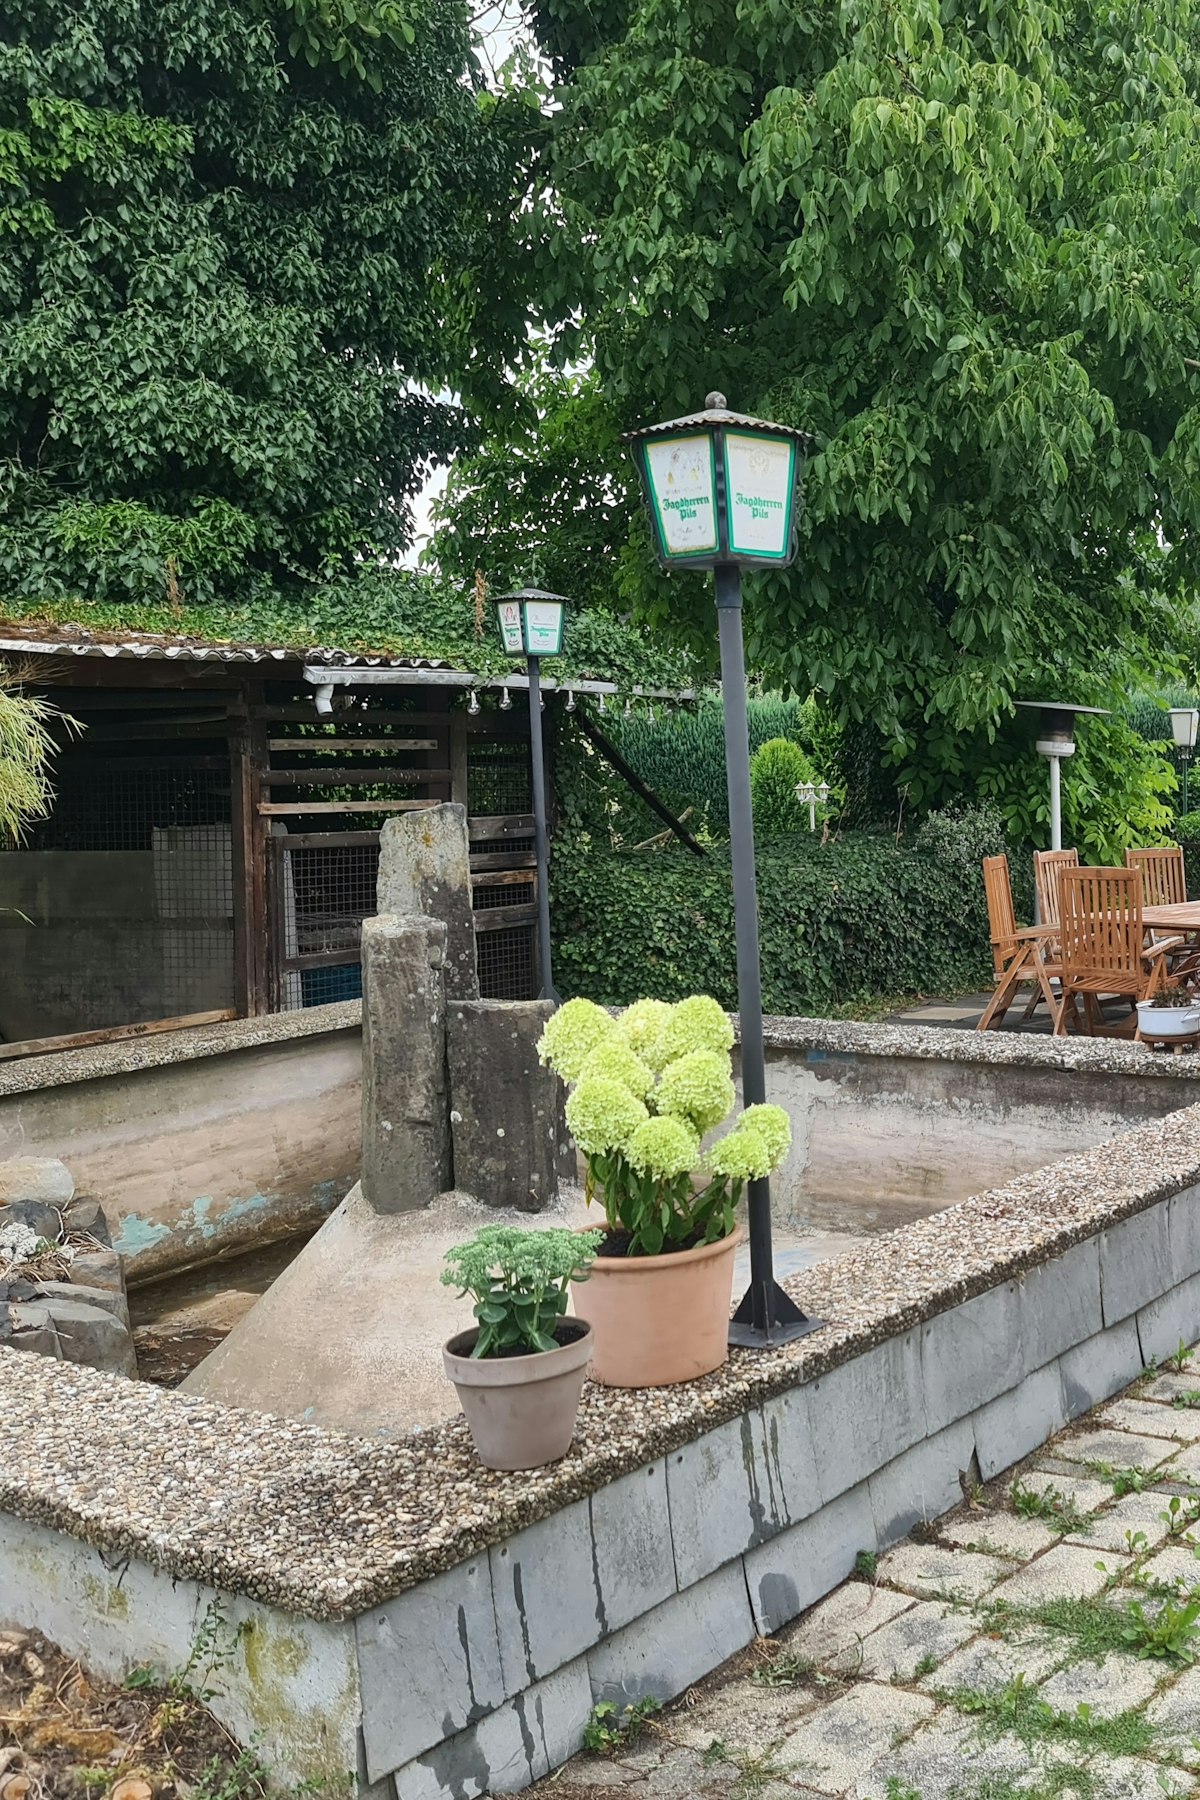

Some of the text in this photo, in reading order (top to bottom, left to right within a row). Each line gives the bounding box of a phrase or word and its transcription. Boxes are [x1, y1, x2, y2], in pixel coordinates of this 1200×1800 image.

[662, 495, 710, 511] Jagdherren
[735, 492, 783, 509] Jagdherren
[679, 508, 697, 521] Pils
[751, 507, 769, 520] Pils
